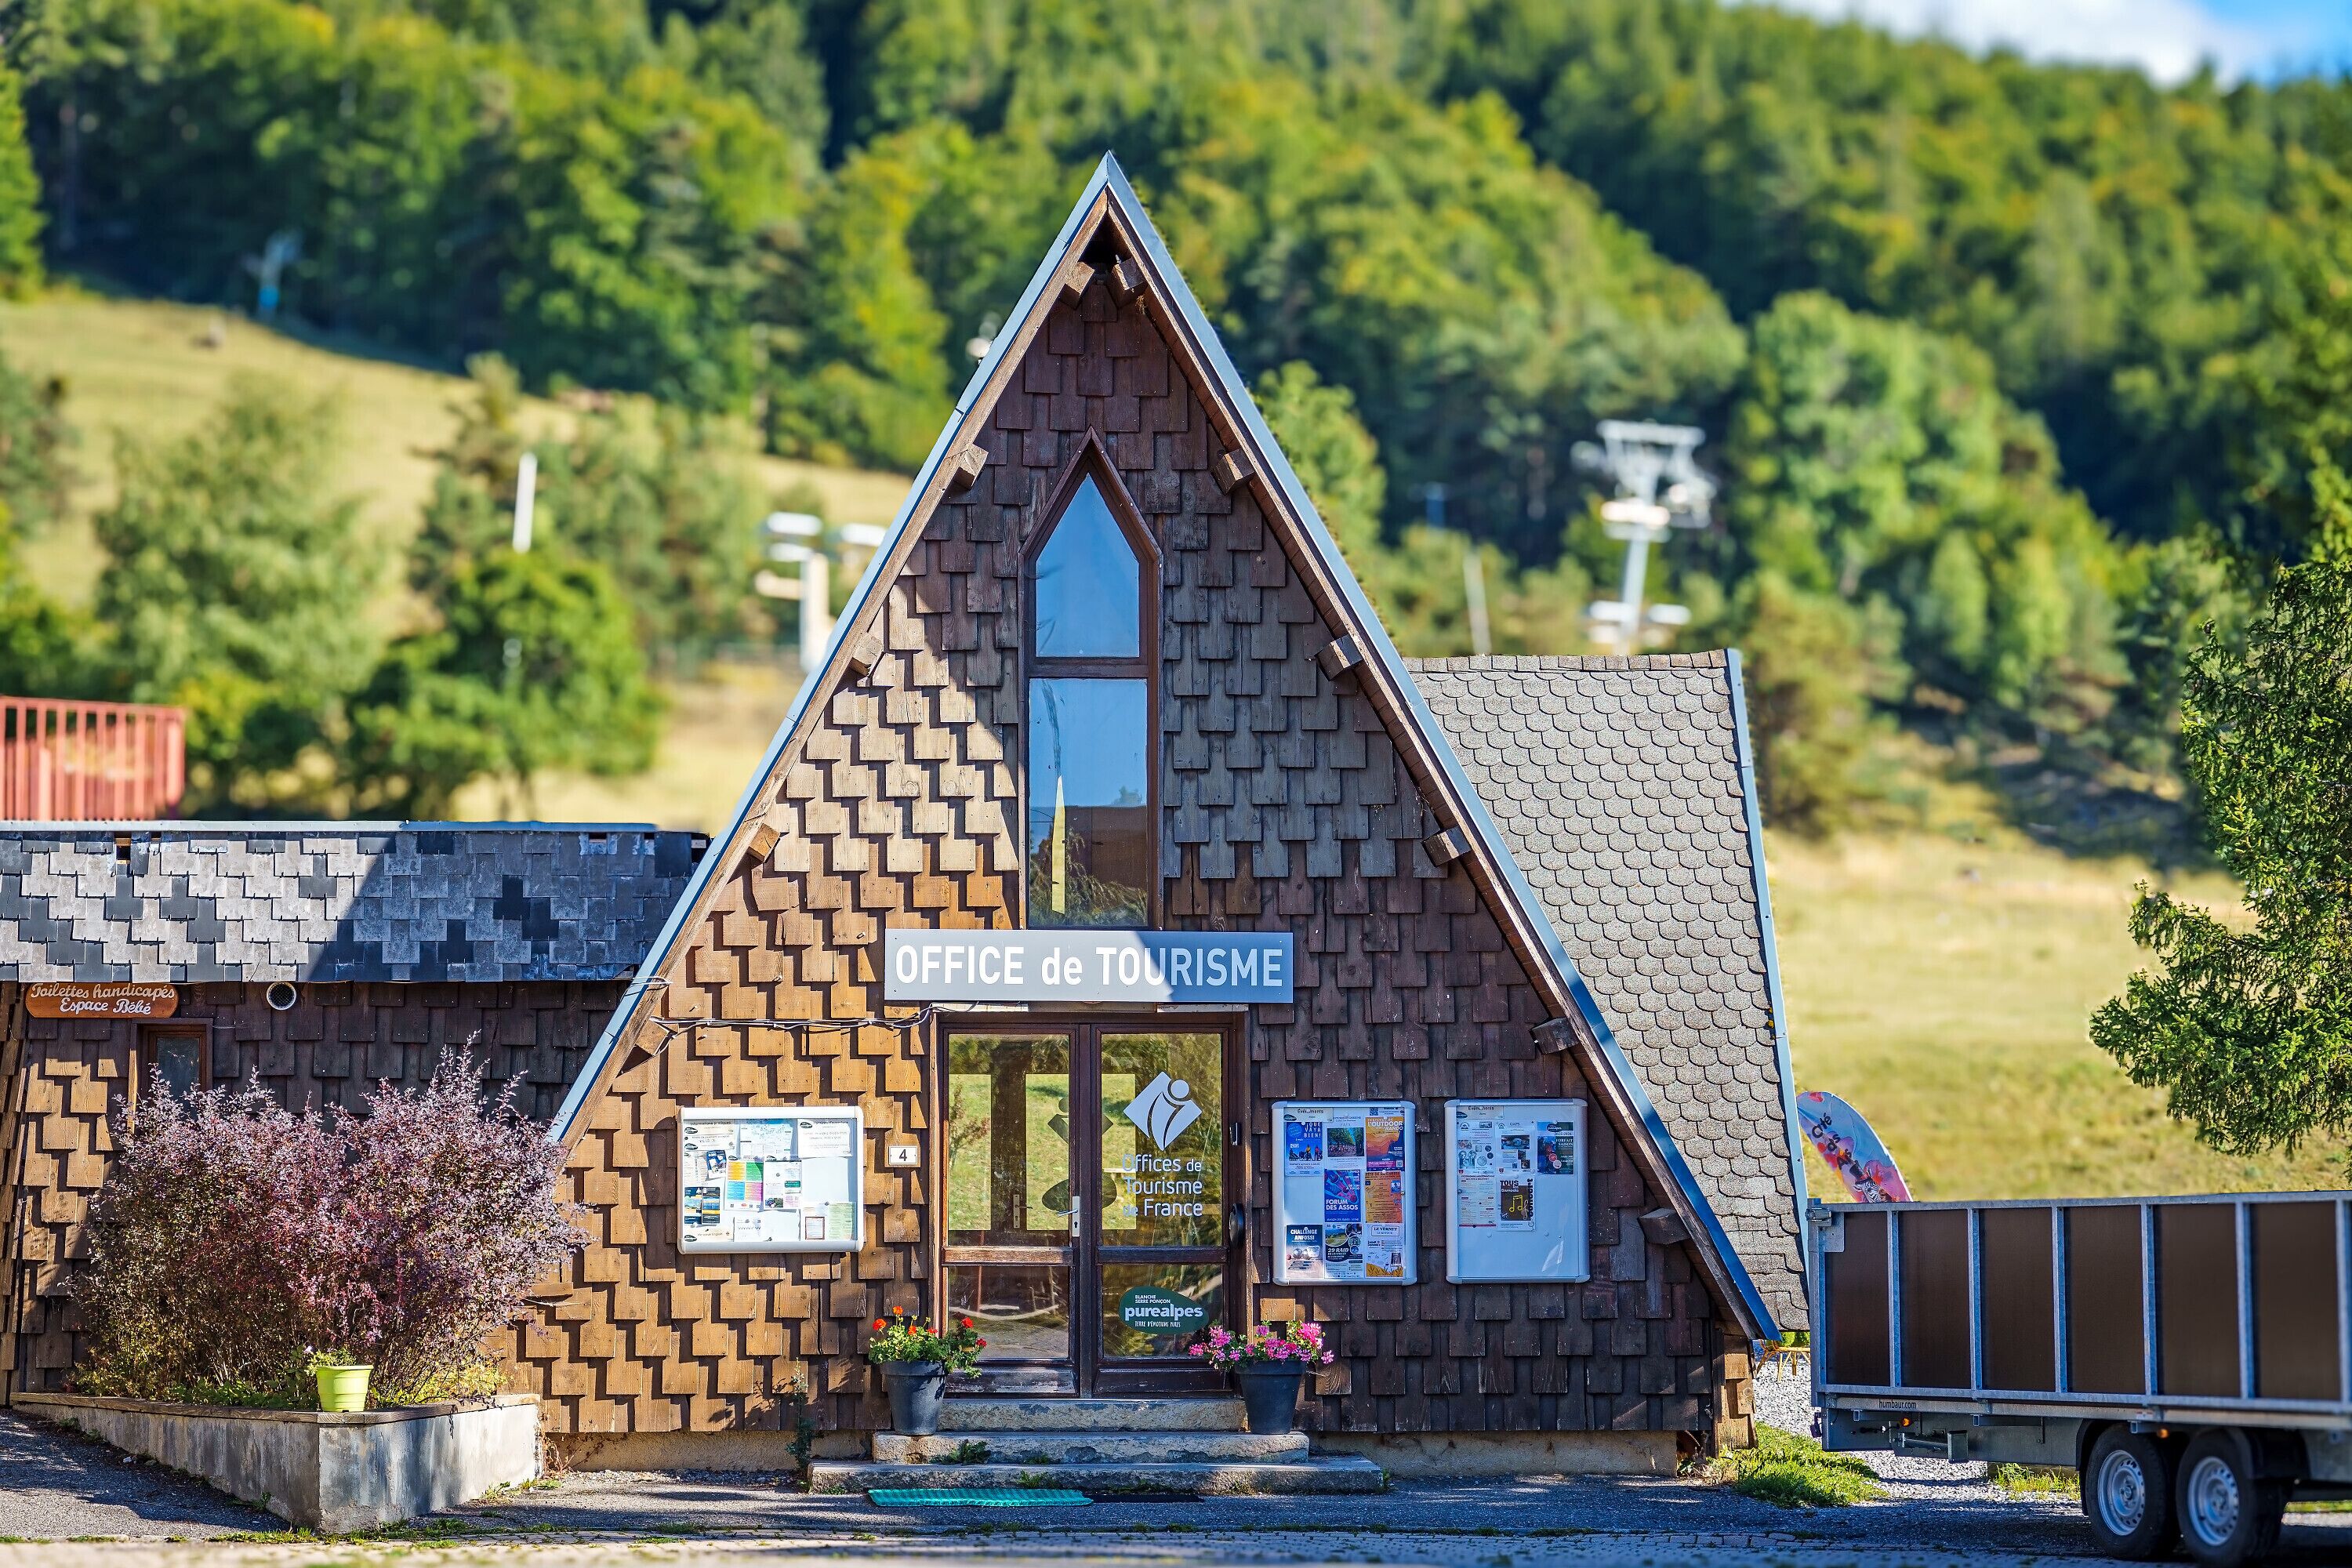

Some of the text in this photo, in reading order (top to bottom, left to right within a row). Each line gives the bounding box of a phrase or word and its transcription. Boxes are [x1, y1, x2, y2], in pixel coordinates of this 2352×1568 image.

[895, 945, 1283, 987] OFFICE de TOURISME
[31, 983, 175, 1000] Toilettes handicapés
[60, 997, 151, 1015] Espace Bébé
[898, 1149, 908, 1161] 4
[1122, 1153, 1202, 1172] Offices de
[1123, 1176, 1203, 1195] Tourisme
[1122, 1198, 1203, 1217] de France
[1125, 1303, 1203, 1321] purealpes
[1878, 1399, 1917, 1409] humbaur.com
